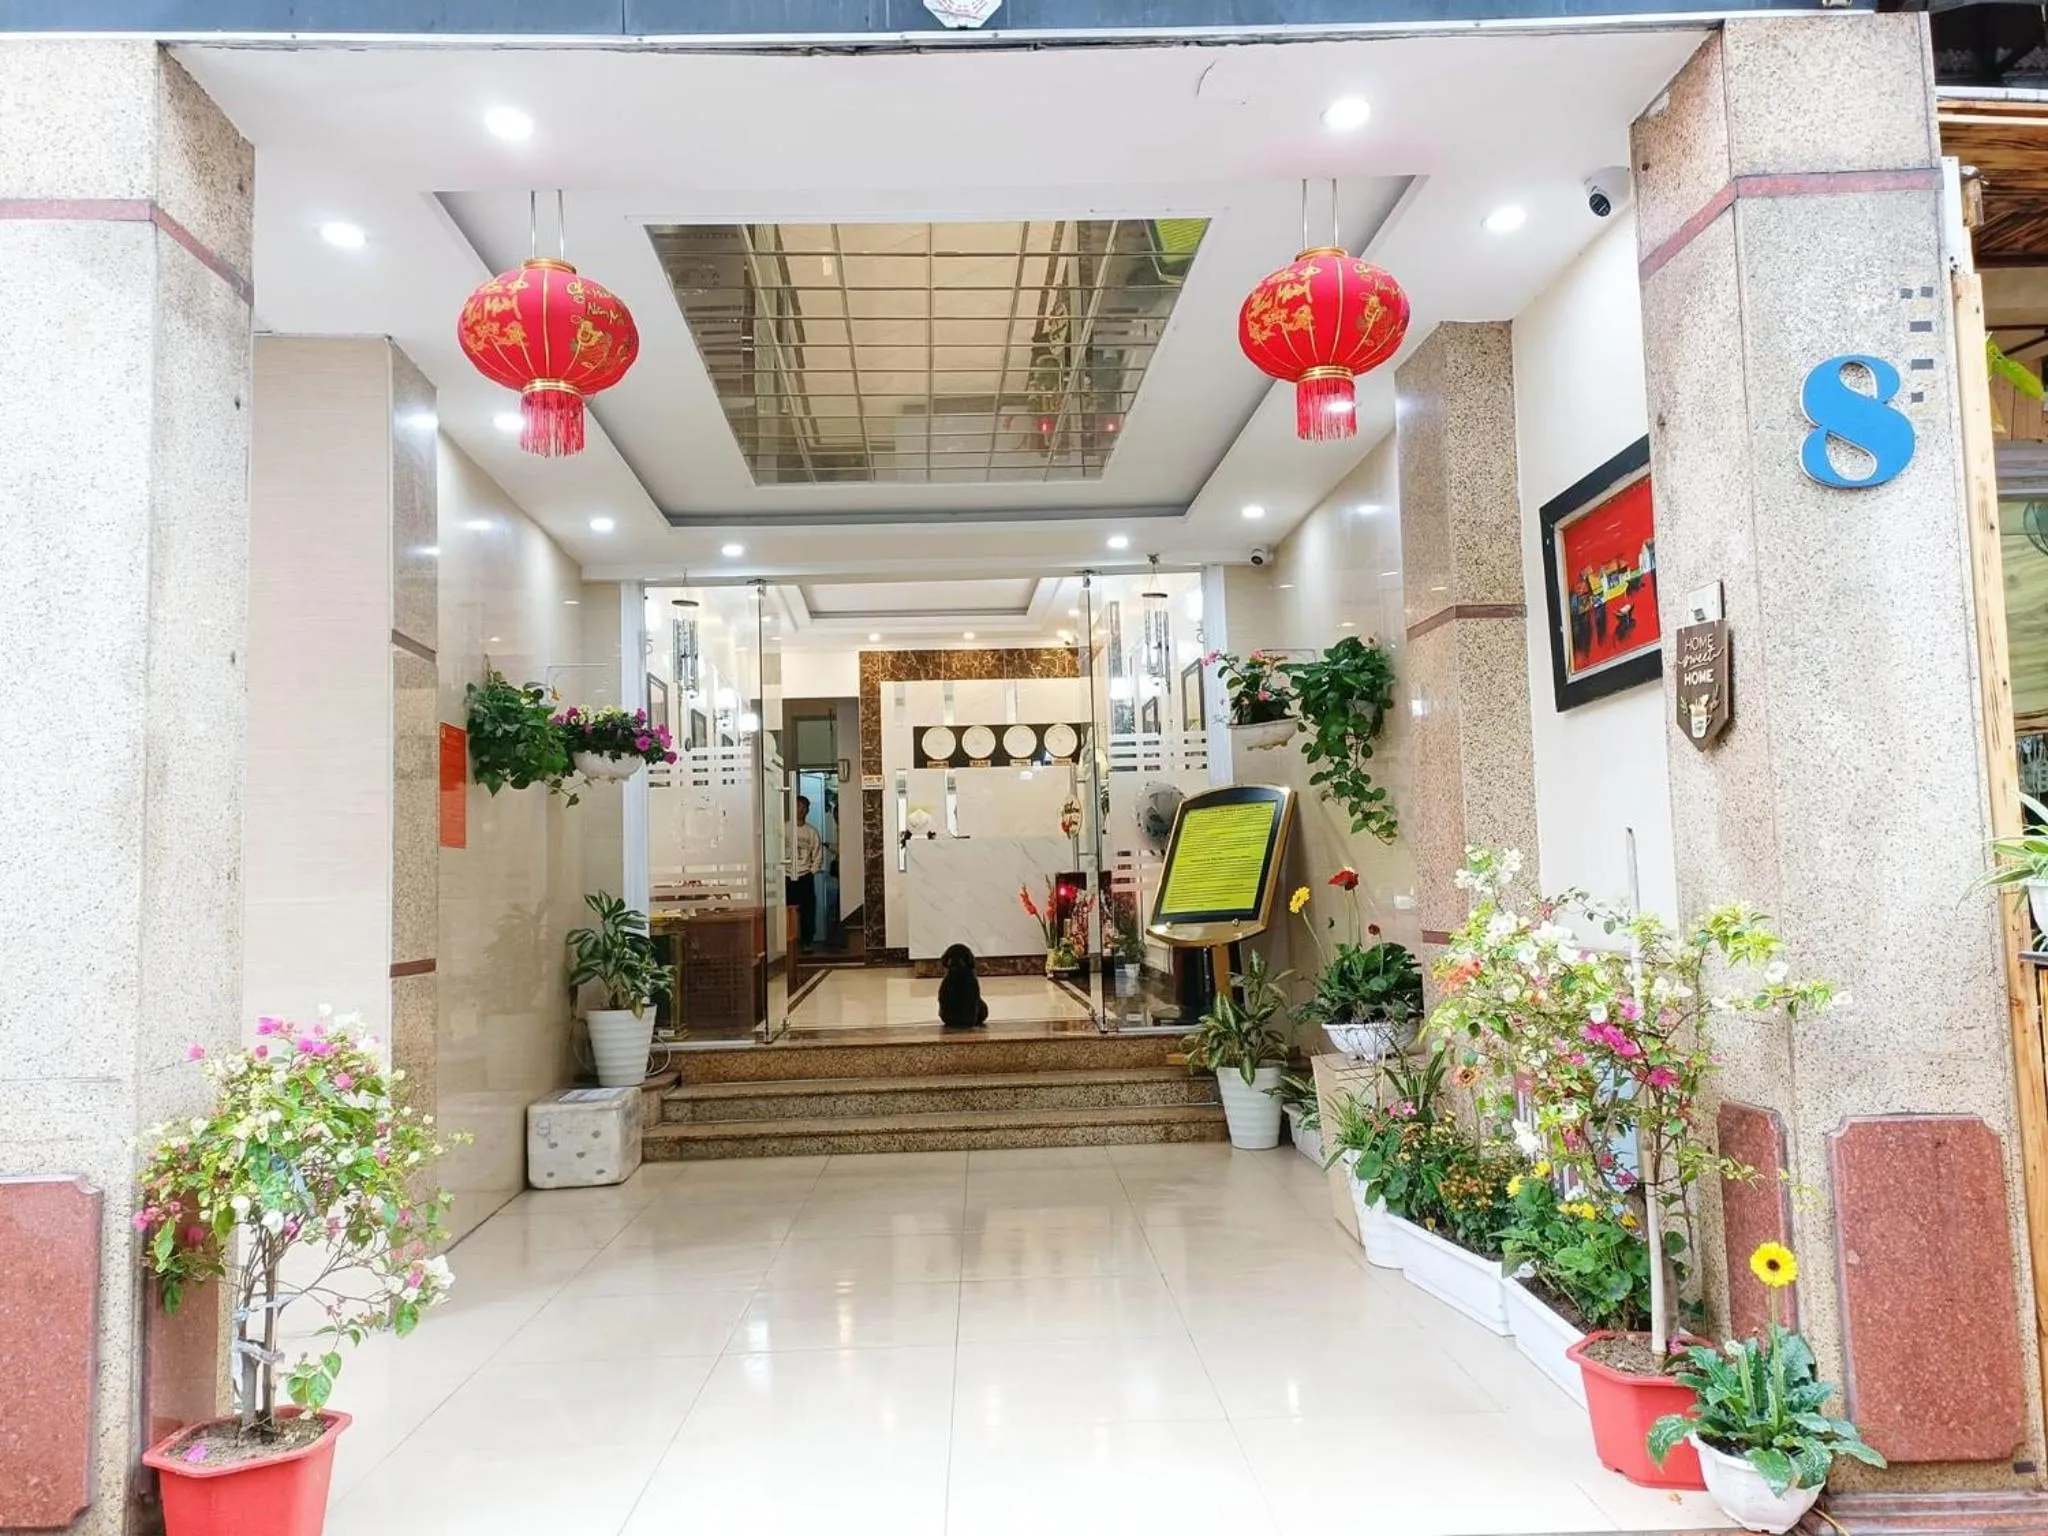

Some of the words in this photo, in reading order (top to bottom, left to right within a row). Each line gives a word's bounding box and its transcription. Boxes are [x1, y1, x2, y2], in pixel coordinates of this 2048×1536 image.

[1800, 354, 1917, 489] 8
[1684, 633, 1714, 652] HOME
[1684, 669, 1715, 686] HOME
